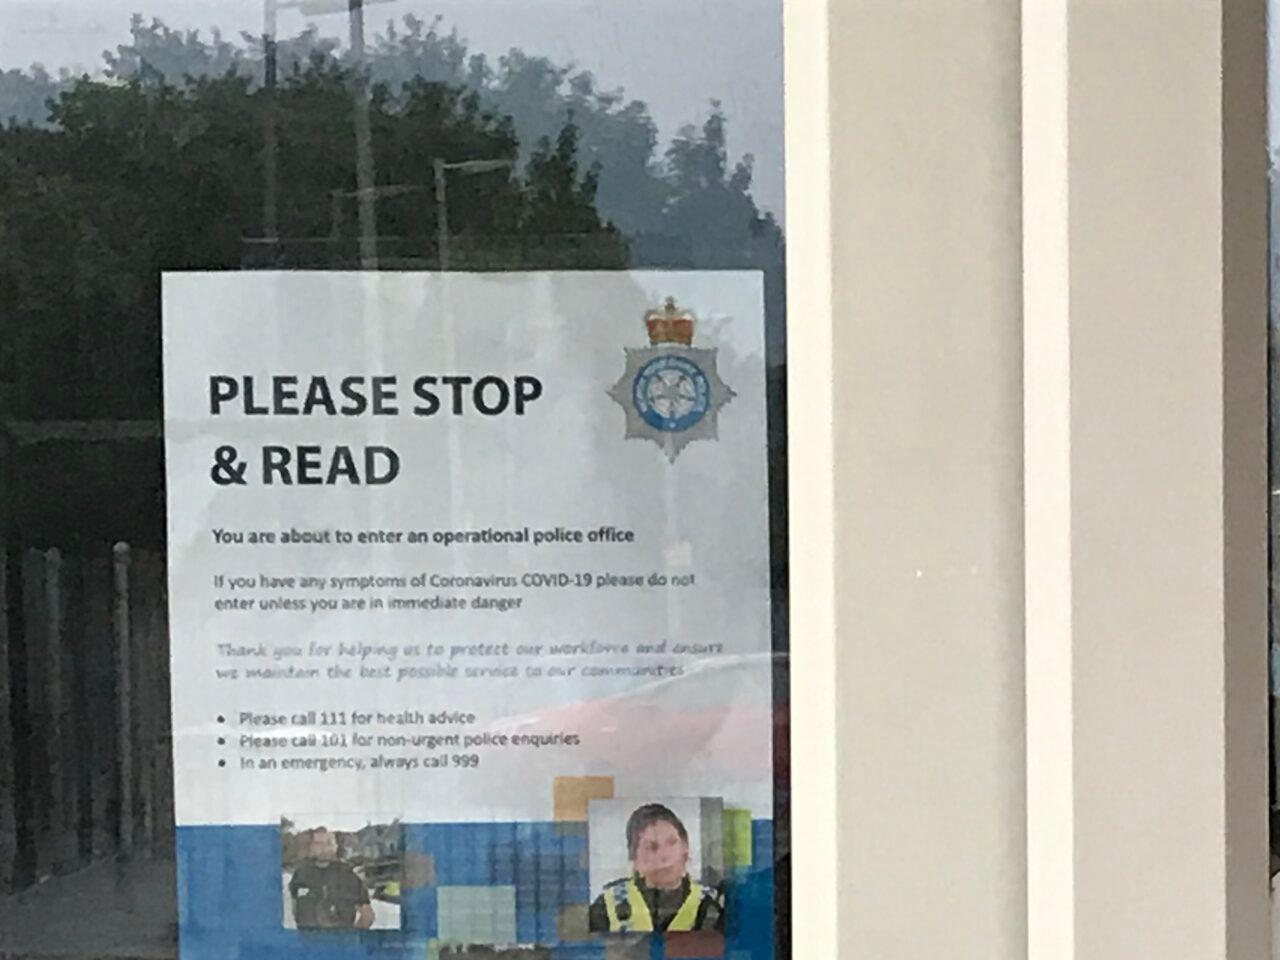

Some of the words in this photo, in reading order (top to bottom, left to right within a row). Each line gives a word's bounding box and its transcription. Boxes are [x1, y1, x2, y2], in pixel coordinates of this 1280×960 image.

[210, 373, 398, 417] PLEASE
[413, 374, 542, 416] STOP
[210, 444, 247, 485] &
[262, 444, 400, 485] READ
[212, 528, 243, 543] You
[247, 531, 275, 544] are
[280, 527, 330, 543] about
[335, 530, 353, 543] to
[357, 530, 403, 543] enter
[407, 531, 428, 543] an
[432, 527, 529, 547] operational
[533, 527, 582, 546] police
[587, 526, 634, 542] office
[214, 574, 224, 588] If
[227, 577, 256, 590] you
[259, 573, 295, 588] have
[299, 576, 326, 590] any
[330, 575, 406, 591] symptoms
[409, 572, 426, 587] of
[429, 573, 517, 588] Coronavirus
[520, 572, 592, 587] COVID-19
[596, 572, 644, 589] please
[647, 572, 667, 587] do
[671, 574, 694, 586] not
[214, 597, 255, 610] enter
[259, 596, 306, 610] unless
[310, 598, 338, 613] you
[341, 598, 366, 610] are
[369, 597, 383, 608] in
[387, 594, 466, 609] immediate
[470, 595, 522, 612] danger
[239, 711, 287, 726] Please
[291, 710, 316, 725] call
[320, 711, 346, 725] 111
[351, 711, 373, 725] for
[376, 710, 424, 725] health
[428, 710, 475, 725] advice
[239, 734, 288, 749] Please
[290, 734, 317, 748] call
[321, 733, 347, 747] 101
[352, 732, 373, 746] for
[377, 734, 459, 750] non-urgent
[463, 732, 508, 748] police
[510, 734, 580, 748] enquiries
[240, 756, 254, 769] In
[258, 757, 277, 769] an
[370, 754, 419, 771] always
[423, 754, 448, 768] call
[451, 753, 479, 768] 999
